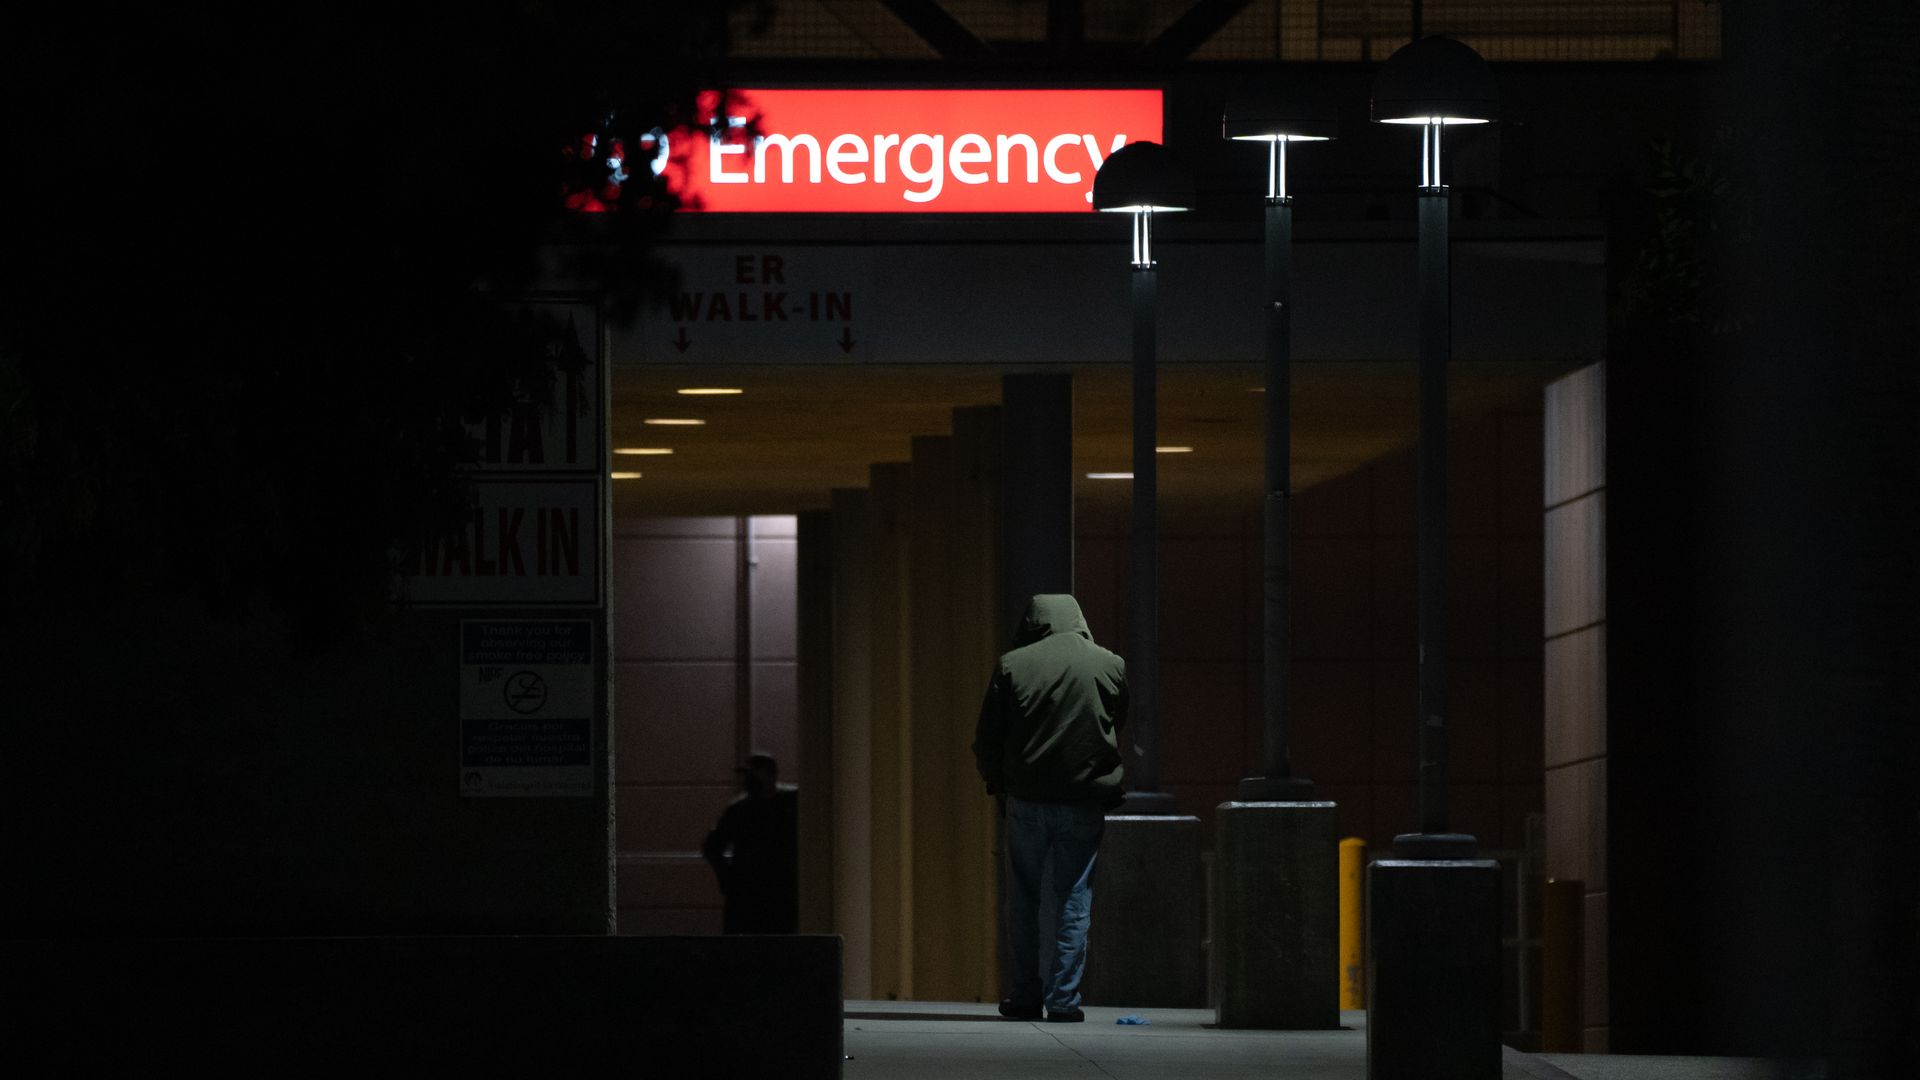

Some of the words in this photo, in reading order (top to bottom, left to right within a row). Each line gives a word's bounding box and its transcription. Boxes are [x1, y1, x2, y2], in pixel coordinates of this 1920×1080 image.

[710, 116, 1127, 203] Emergency
[735, 254, 785, 285] ER
[668, 291, 852, 322] WALK-IN
[537, 507, 579, 577] IN
[480, 624, 522, 636] Thank
[526, 626, 551, 641] you
[480, 637, 546, 650] observing
[550, 639, 572, 648] our
[468, 650, 512, 661] smoke
[516, 650, 542, 661] free
[546, 650, 585, 664] policy
